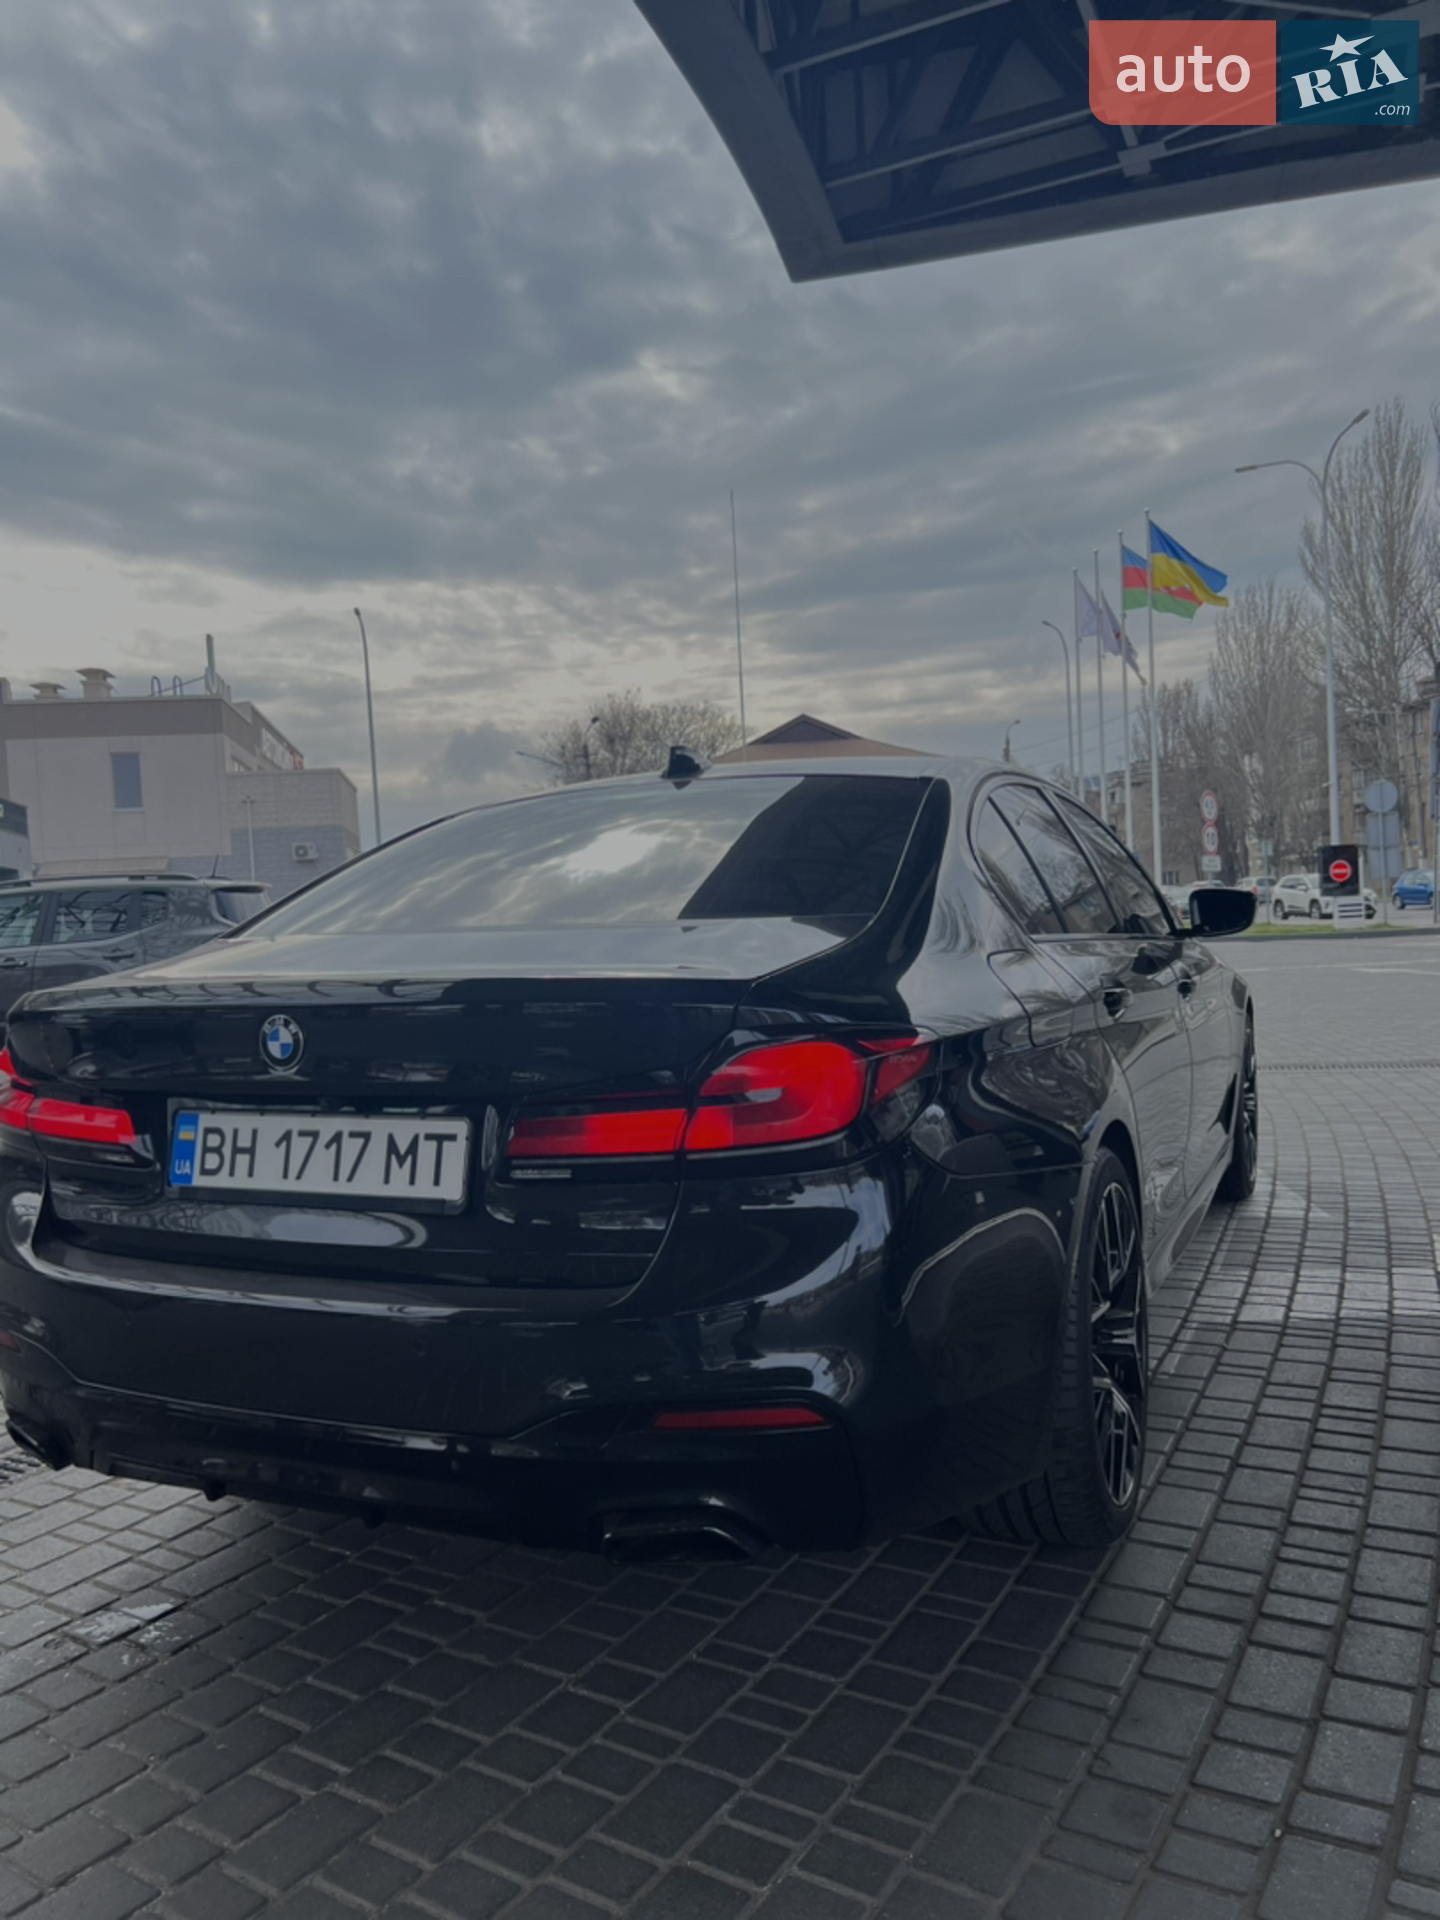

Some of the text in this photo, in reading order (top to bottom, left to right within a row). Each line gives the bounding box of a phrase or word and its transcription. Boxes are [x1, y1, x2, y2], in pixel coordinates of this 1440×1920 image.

[174, 1159, 191, 1175] UA
[199, 1127, 458, 1187] BH 1717 MT
